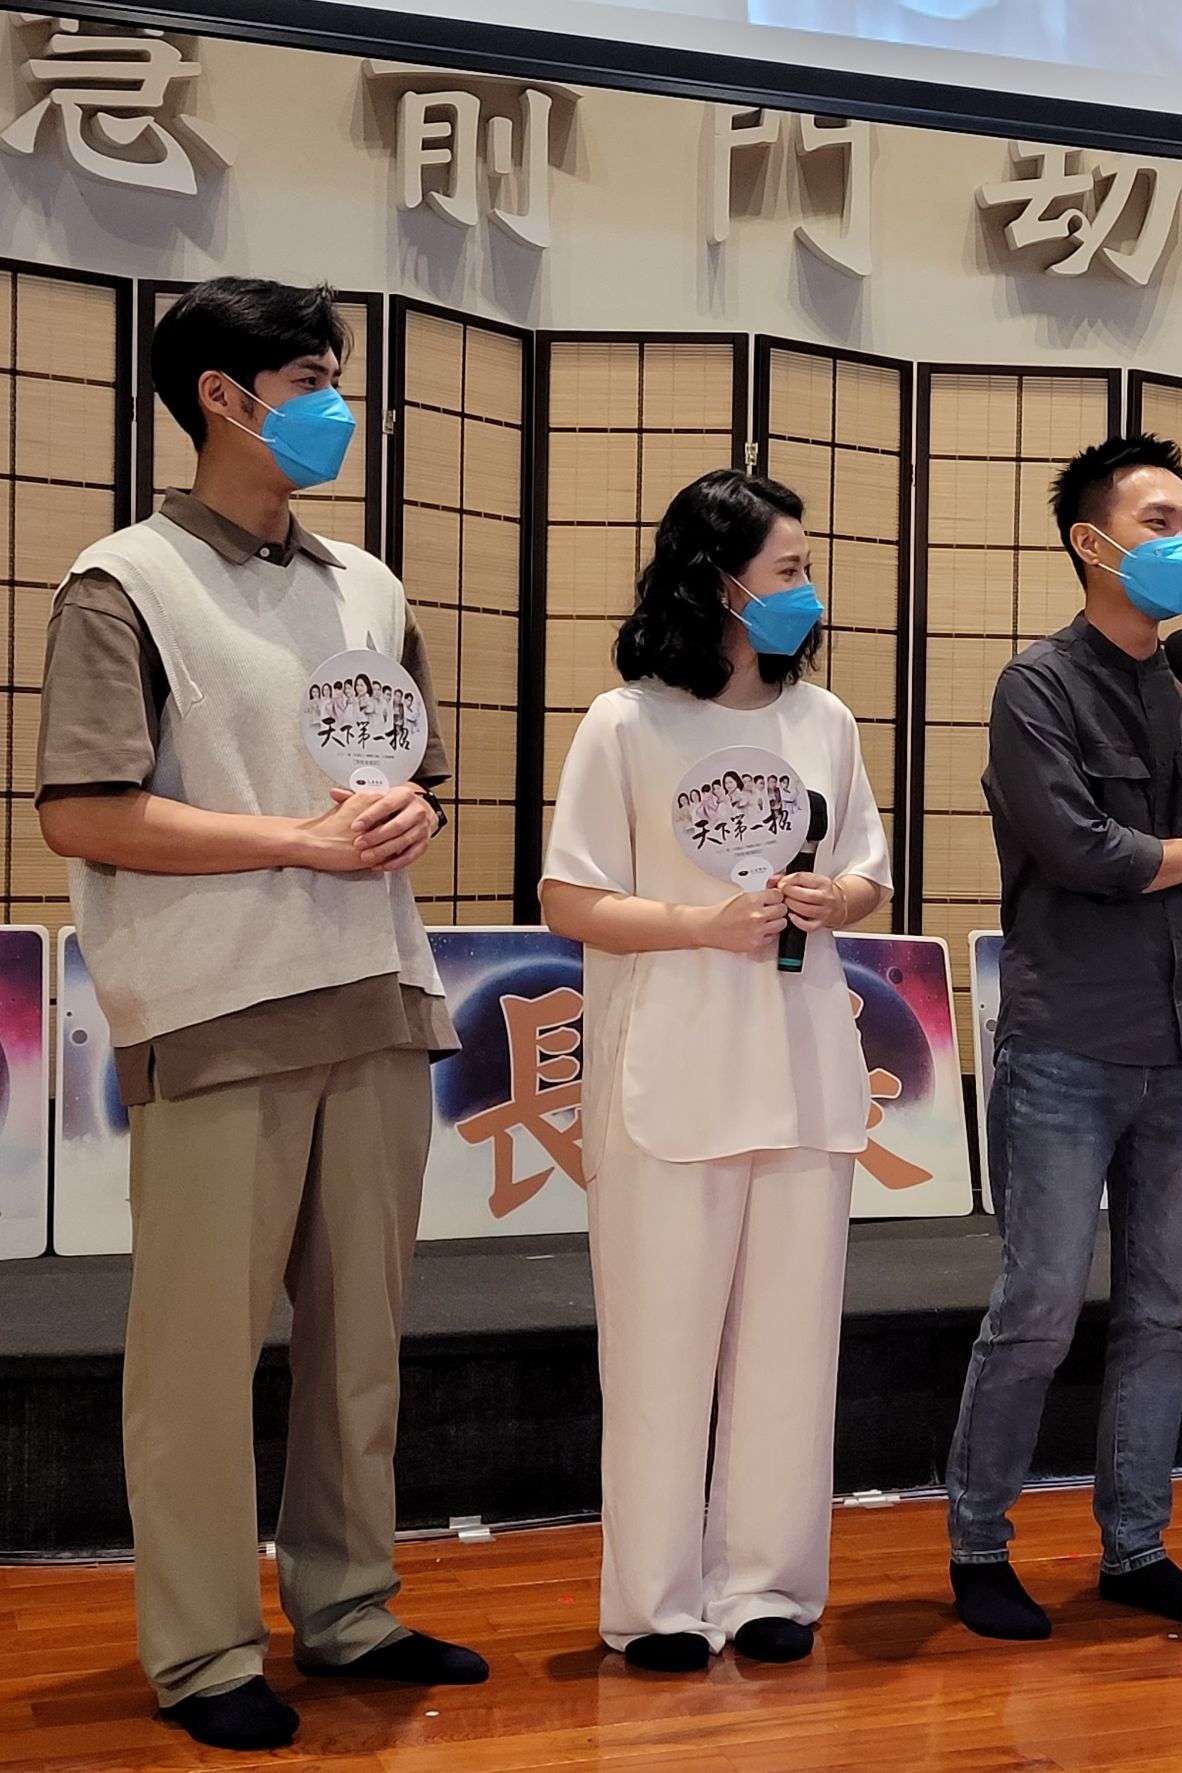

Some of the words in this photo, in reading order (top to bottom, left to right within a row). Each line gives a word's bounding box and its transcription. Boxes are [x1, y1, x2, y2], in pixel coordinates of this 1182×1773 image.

[714, 101, 874, 277] 門
[317, 716, 411, 751] 天下第一招
[691, 808, 793, 850] 天下第一招
